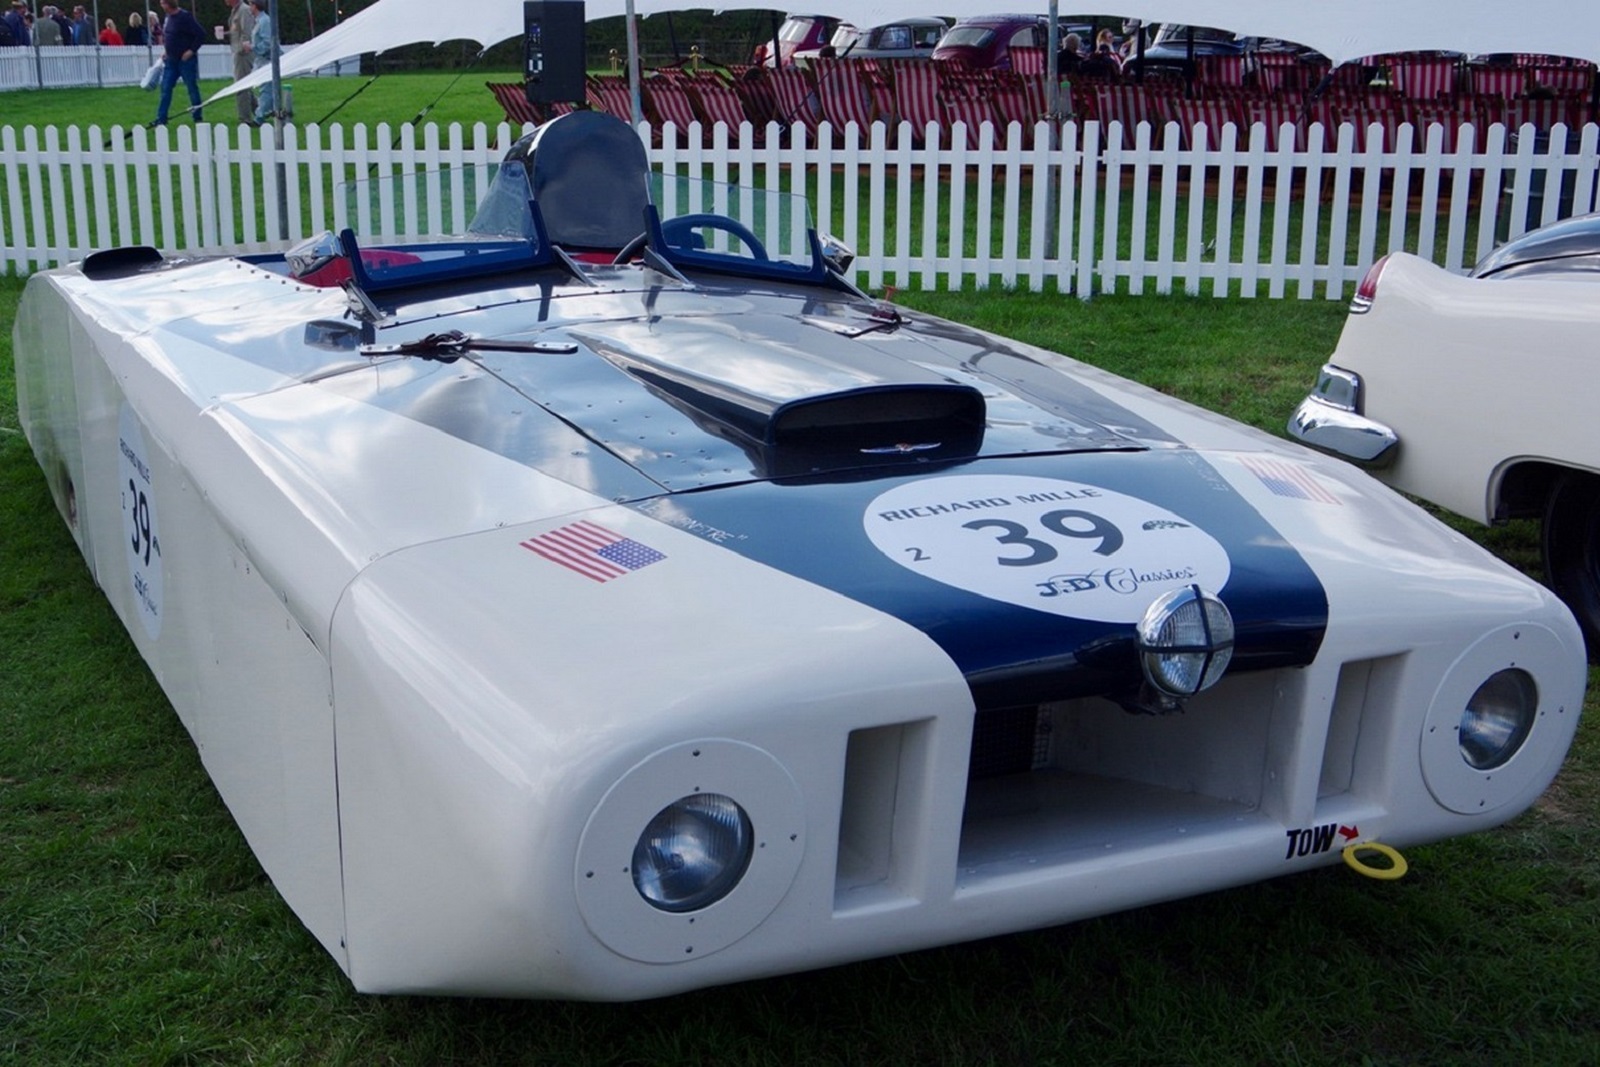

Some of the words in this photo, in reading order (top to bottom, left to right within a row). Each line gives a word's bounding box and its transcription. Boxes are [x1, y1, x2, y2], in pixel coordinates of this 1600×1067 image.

[129, 478, 150, 567] 39
[878, 497, 1013, 522] RICHARD
[1017, 488, 1103, 504] MILLE
[904, 546, 932, 562] 2
[961, 508, 1125, 567] 39
[1103, 566, 1194, 595] Classics
[1285, 823, 1337, 860] TOW
